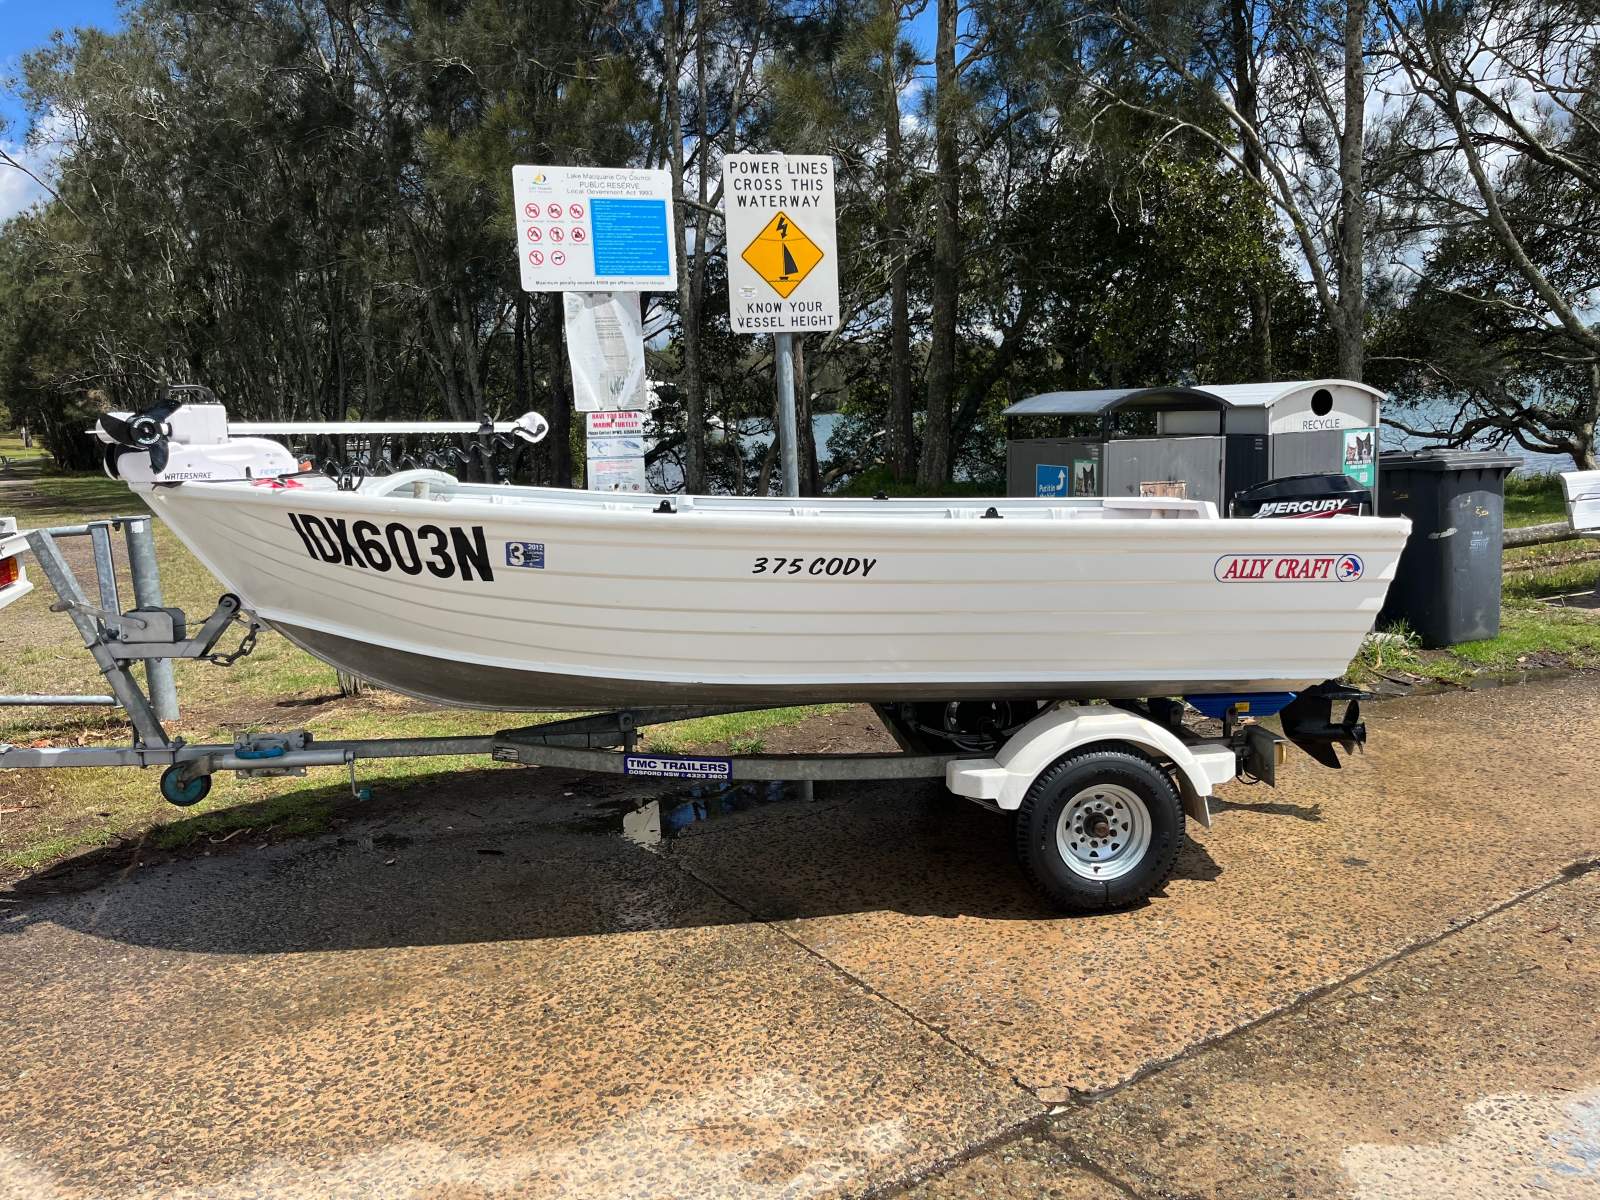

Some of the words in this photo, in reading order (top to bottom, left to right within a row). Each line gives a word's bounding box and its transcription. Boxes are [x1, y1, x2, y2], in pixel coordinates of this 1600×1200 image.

[730, 162, 779, 174] POWER
[788, 162, 828, 174] LINES
[734, 178, 782, 191] CROSS
[792, 178, 823, 191] THIS
[737, 195, 820, 208] WATERWAY
[747, 302, 782, 314] KNOW
[790, 302, 823, 312] YOUR
[737, 316, 785, 328] VESSEL
[791, 315, 834, 327] HEIGHT
[1302, 418, 1340, 430] RECYCLE
[164, 472, 213, 480] WATERSNAKE
[1255, 499, 1348, 516] MERCURY
[287, 512, 494, 582] IDX603N
[509, 542, 524, 566] 3
[752, 557, 804, 574] 375
[808, 557, 877, 577] CODY
[1222, 558, 1270, 579] ALLY
[1274, 558, 1335, 579] CRAFT
[629, 759, 657, 769] TMC
[660, 762, 727, 772] TRAILERS
